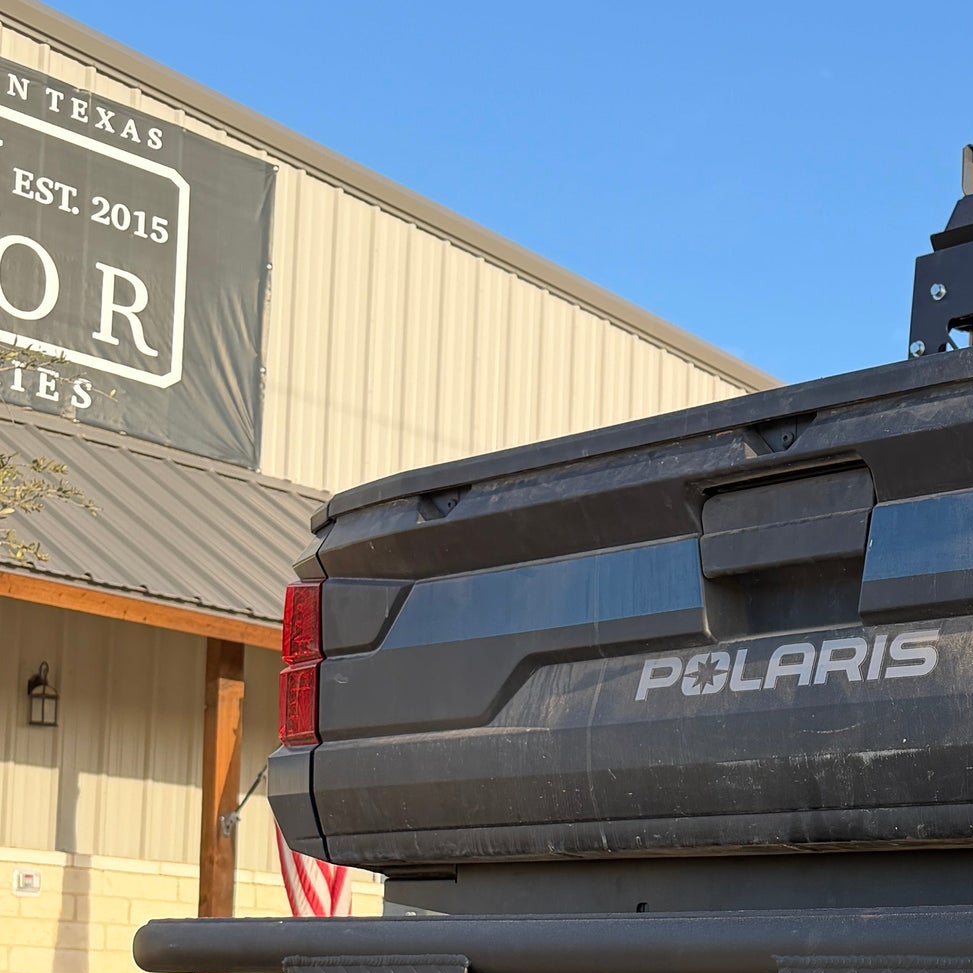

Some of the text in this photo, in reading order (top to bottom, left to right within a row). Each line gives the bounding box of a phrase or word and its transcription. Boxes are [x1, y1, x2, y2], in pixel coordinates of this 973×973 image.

[7, 73, 163, 150] N TEXAS
[12, 167, 169, 244] EST. 2015
[635, 628, 942, 701] POLARIS
